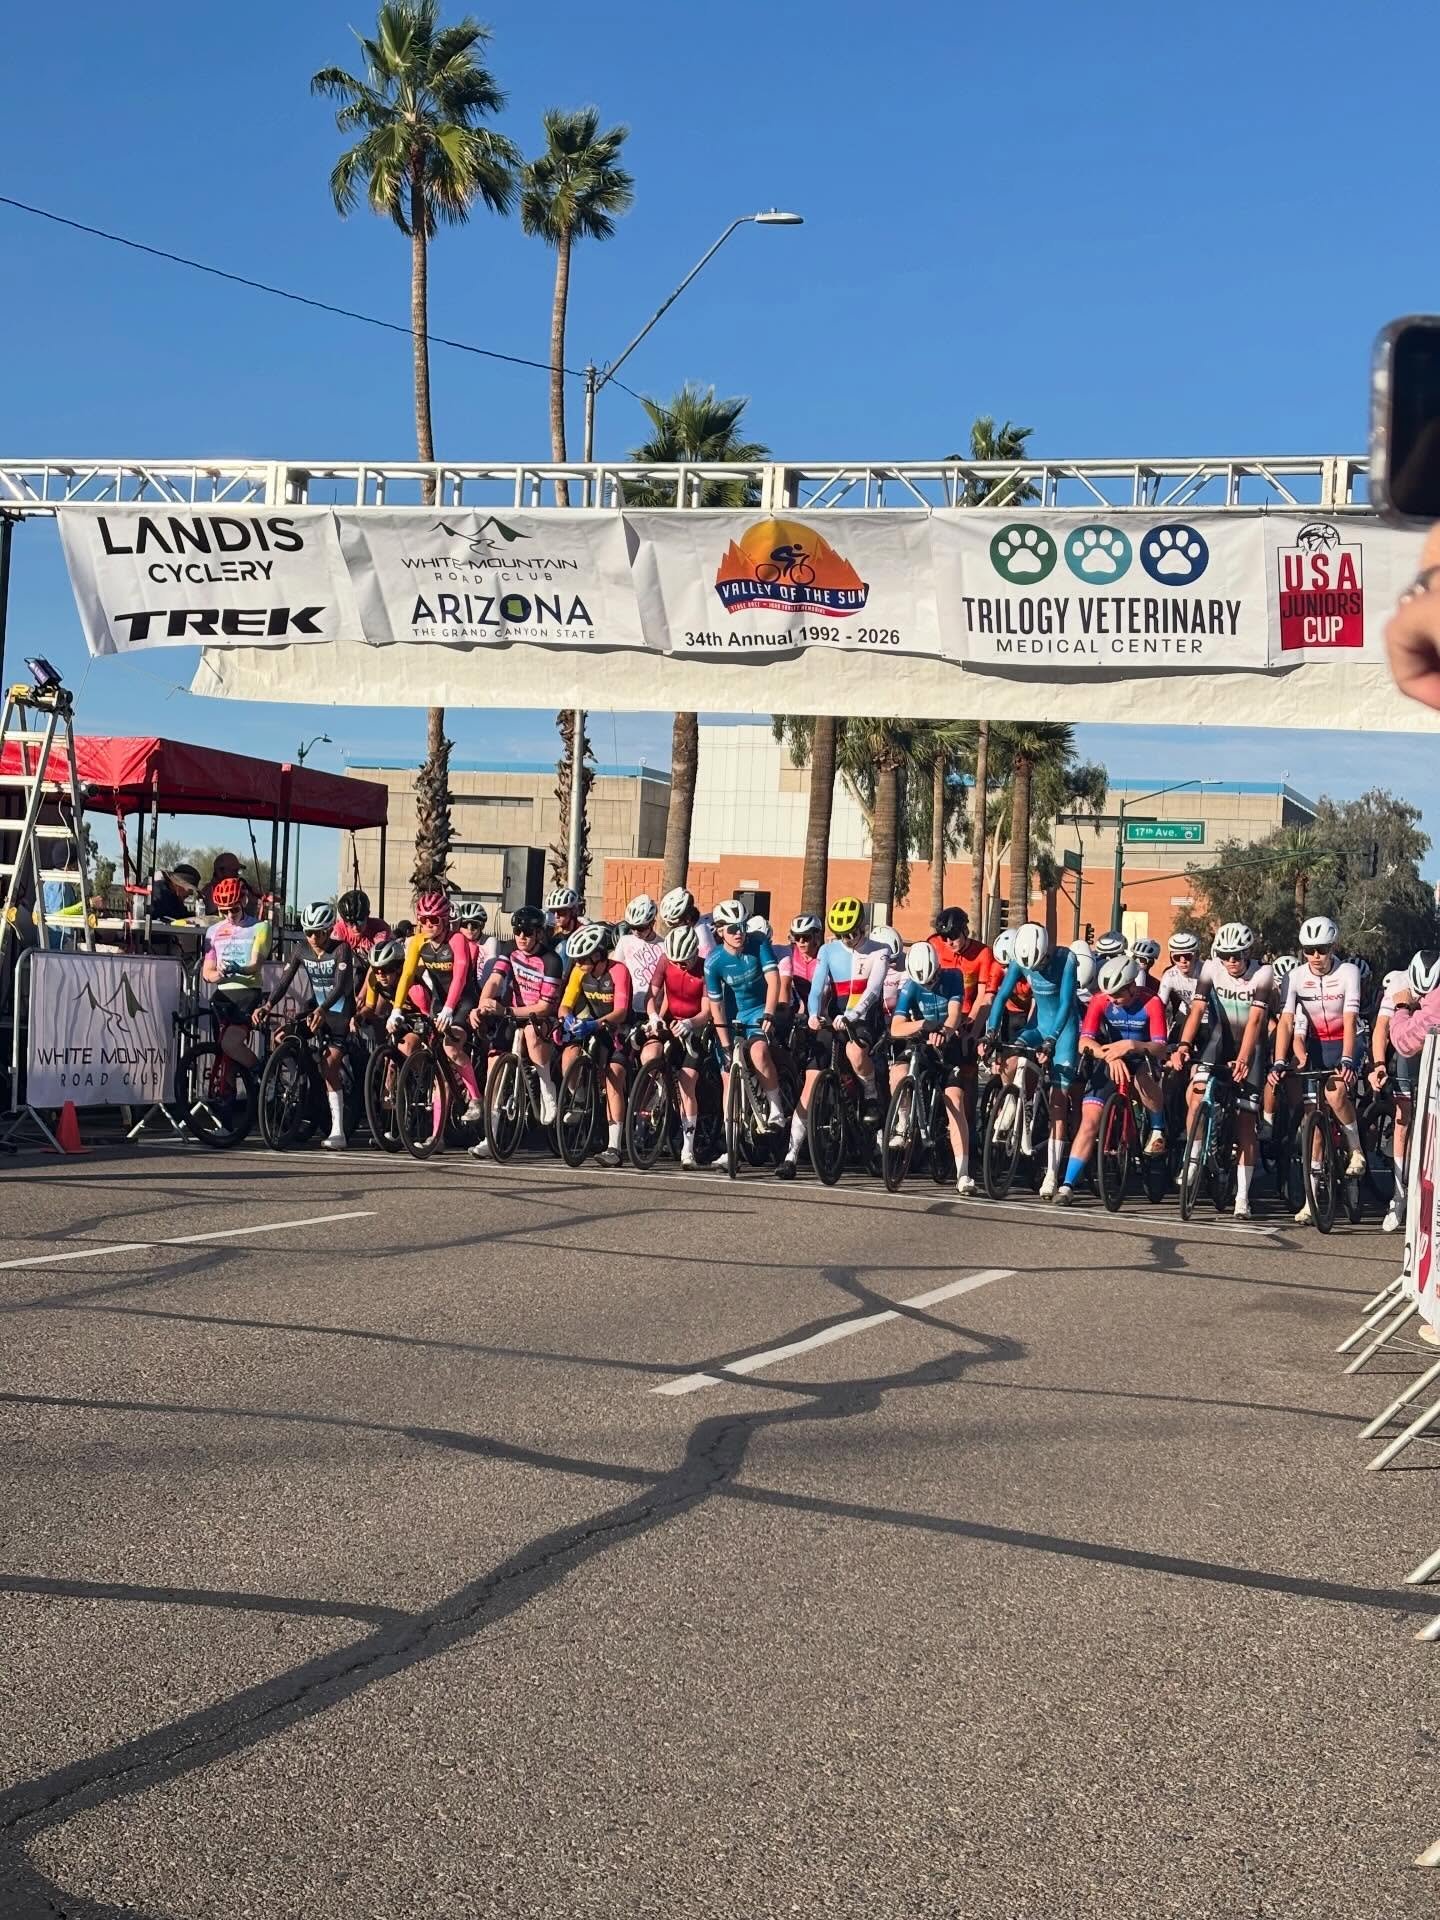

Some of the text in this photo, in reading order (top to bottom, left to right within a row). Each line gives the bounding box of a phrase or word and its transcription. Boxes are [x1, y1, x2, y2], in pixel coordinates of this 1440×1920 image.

[97, 516, 304, 555] LANDIS
[148, 560, 273, 584] CYCLERY
[401, 557, 578, 570] WHITE MOUNTAIN
[1284, 552, 1359, 591] USA
[434, 572, 553, 585] ROAD CLUB
[721, 582, 866, 605] VALLEY OF THE SUN
[1281, 592, 1361, 618] JUNIORS
[411, 593, 594, 626] ARIZONA
[962, 597, 1242, 635] TRILOGY VETERINARY
[114, 606, 327, 641] TREK
[412, 628, 596, 639] THE GRAND CANYON STATE
[1303, 616, 1344, 643] CUP
[685, 631, 723, 647] 34th
[728, 630, 793, 647] Annual
[800, 626, 840, 643] 1992
[858, 628, 901, 645] 2026
[996, 639, 1204, 654] MEDICAL CENTER
[1135, 827, 1178, 837] 17th Ave.
[38, 1047, 93, 1065] WHITE
[60, 1072, 159, 1087] ROAD CLUB
